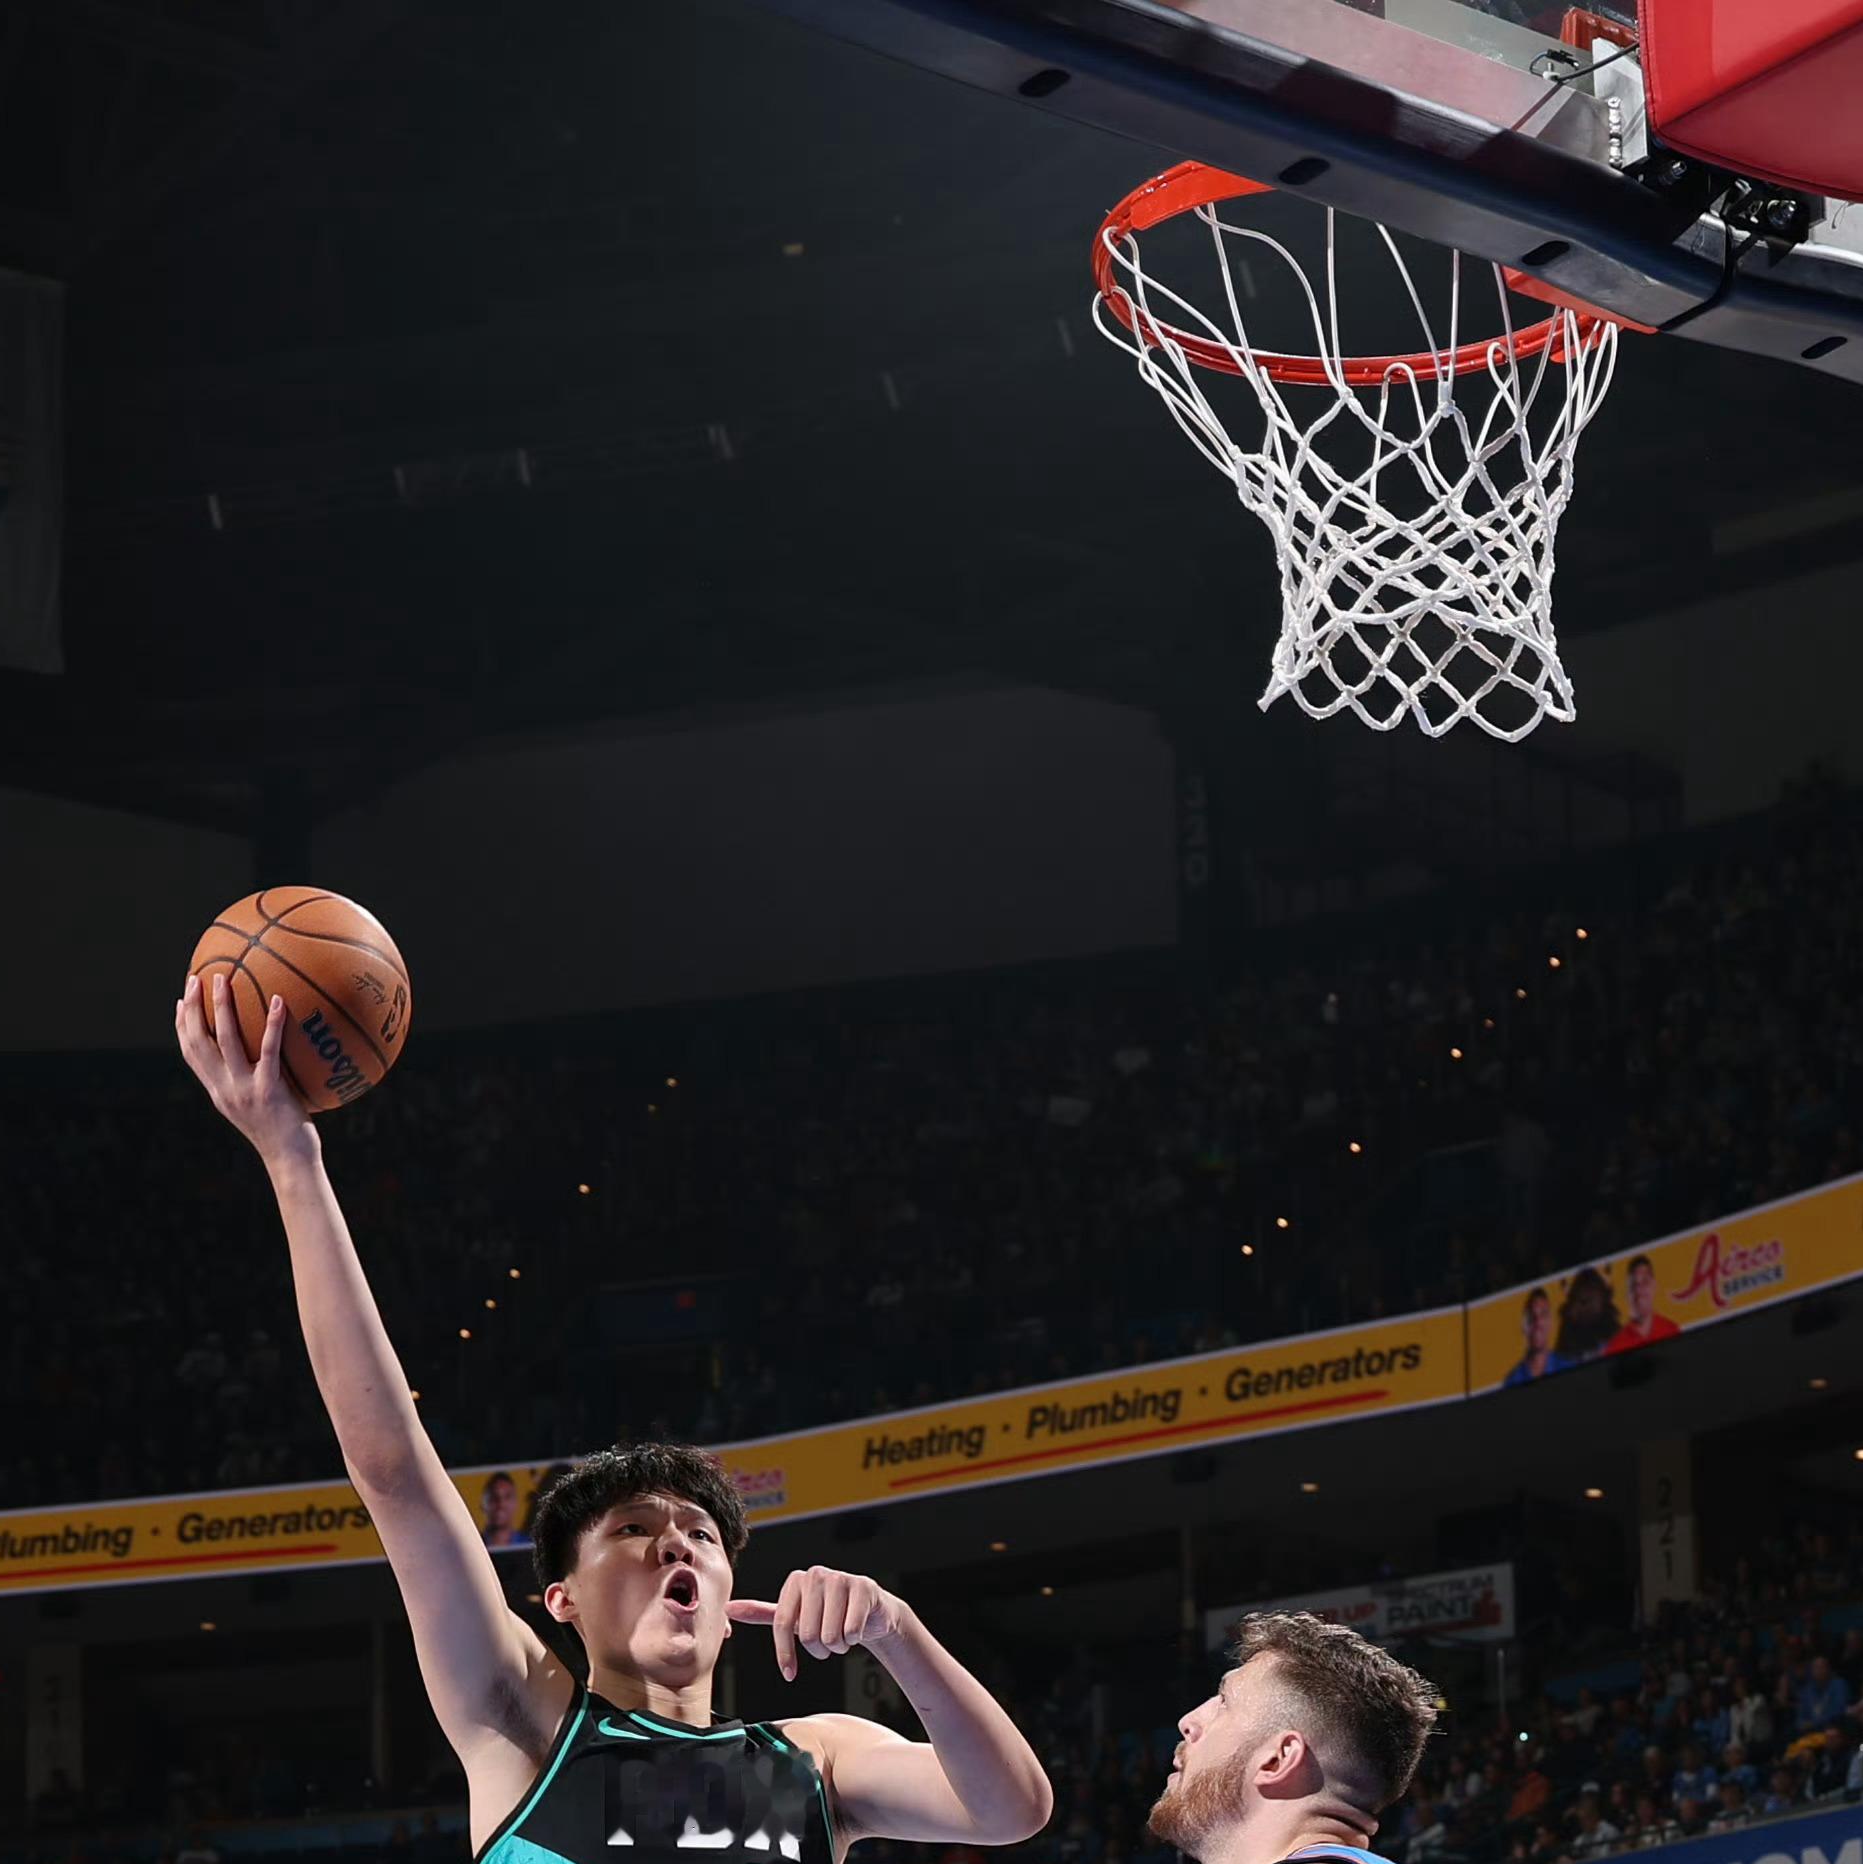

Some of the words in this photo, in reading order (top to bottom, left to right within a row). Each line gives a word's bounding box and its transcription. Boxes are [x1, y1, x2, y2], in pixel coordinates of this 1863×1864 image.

[1670, 1231, 1786, 1311] Airco
[1722, 1264, 1786, 1299] SERVICE
[863, 1422, 985, 1470] Heating
[1025, 1387, 1181, 1438] Plumbing
[1224, 1342, 1421, 1401] Generators
[175, 1505, 372, 1545] Generators
